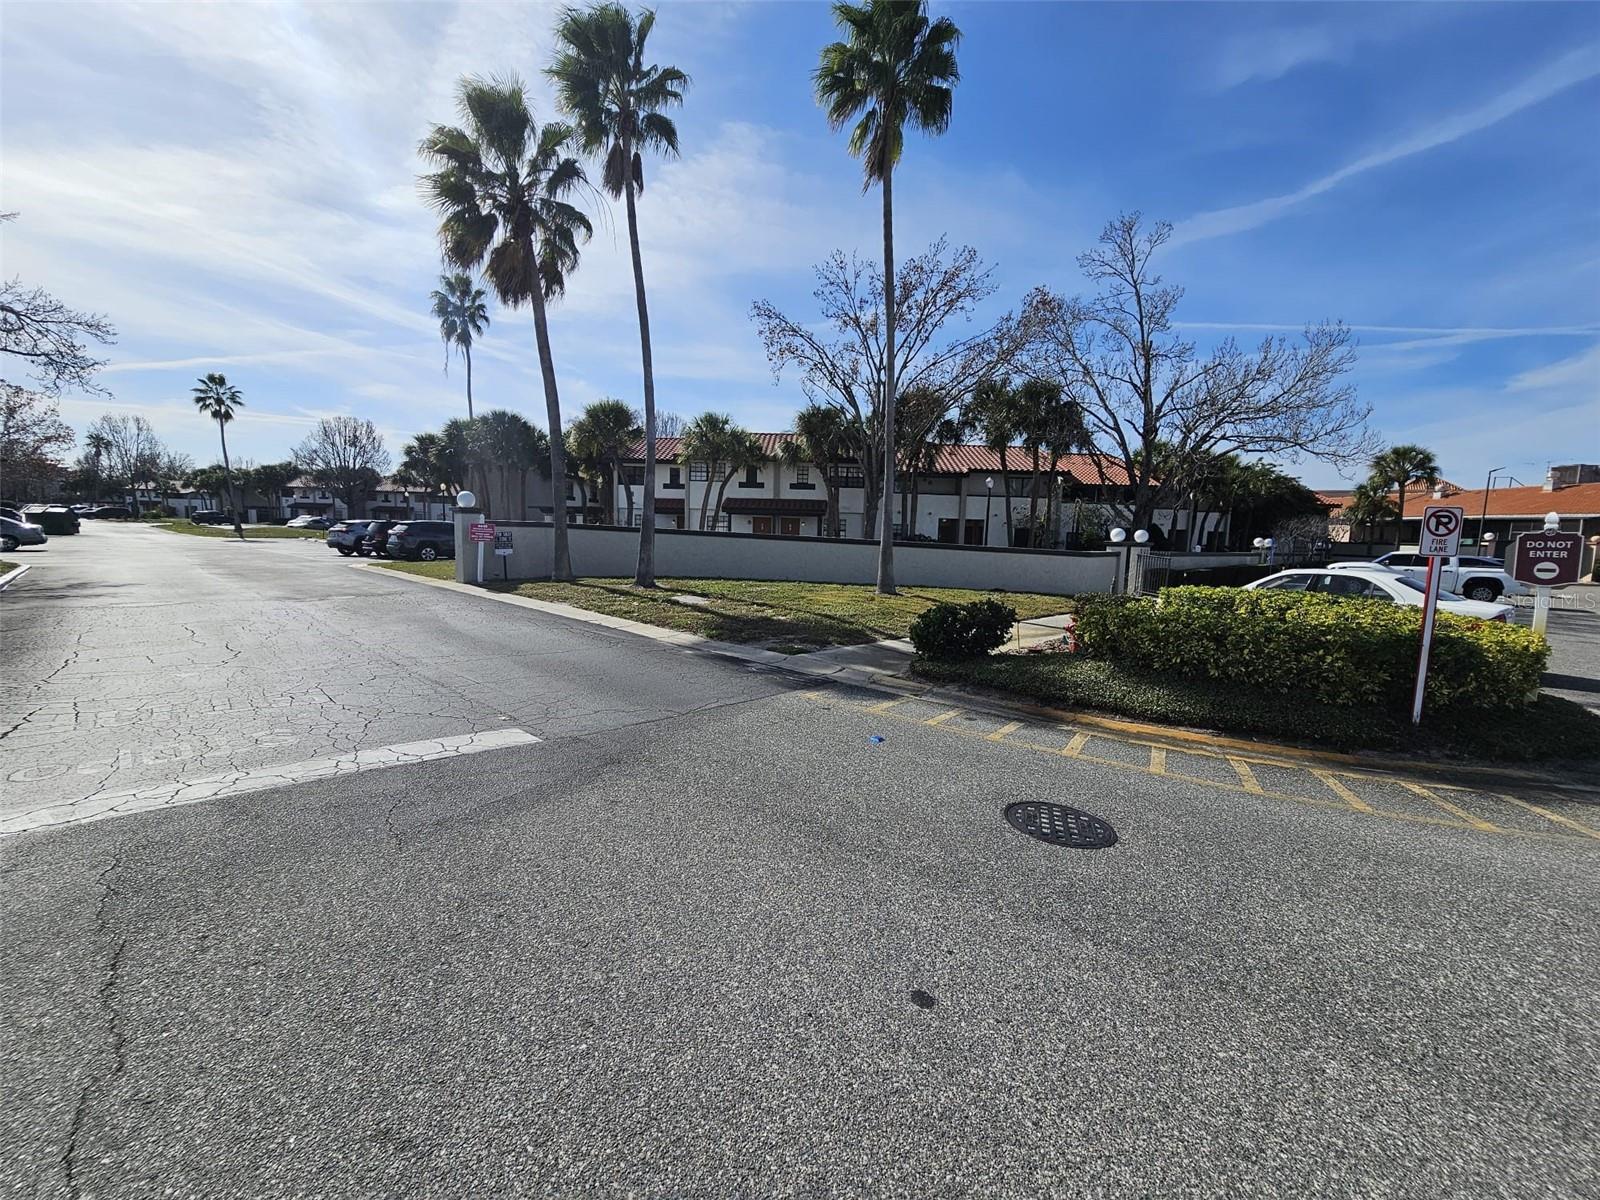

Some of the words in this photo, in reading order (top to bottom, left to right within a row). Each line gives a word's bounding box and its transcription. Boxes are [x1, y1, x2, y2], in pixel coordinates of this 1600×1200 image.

[1432, 538, 1448, 546] FIRE
[1526, 540, 1544, 549] DO
[1547, 540, 1574, 549] NOT
[1529, 550, 1568, 559] ENTER
